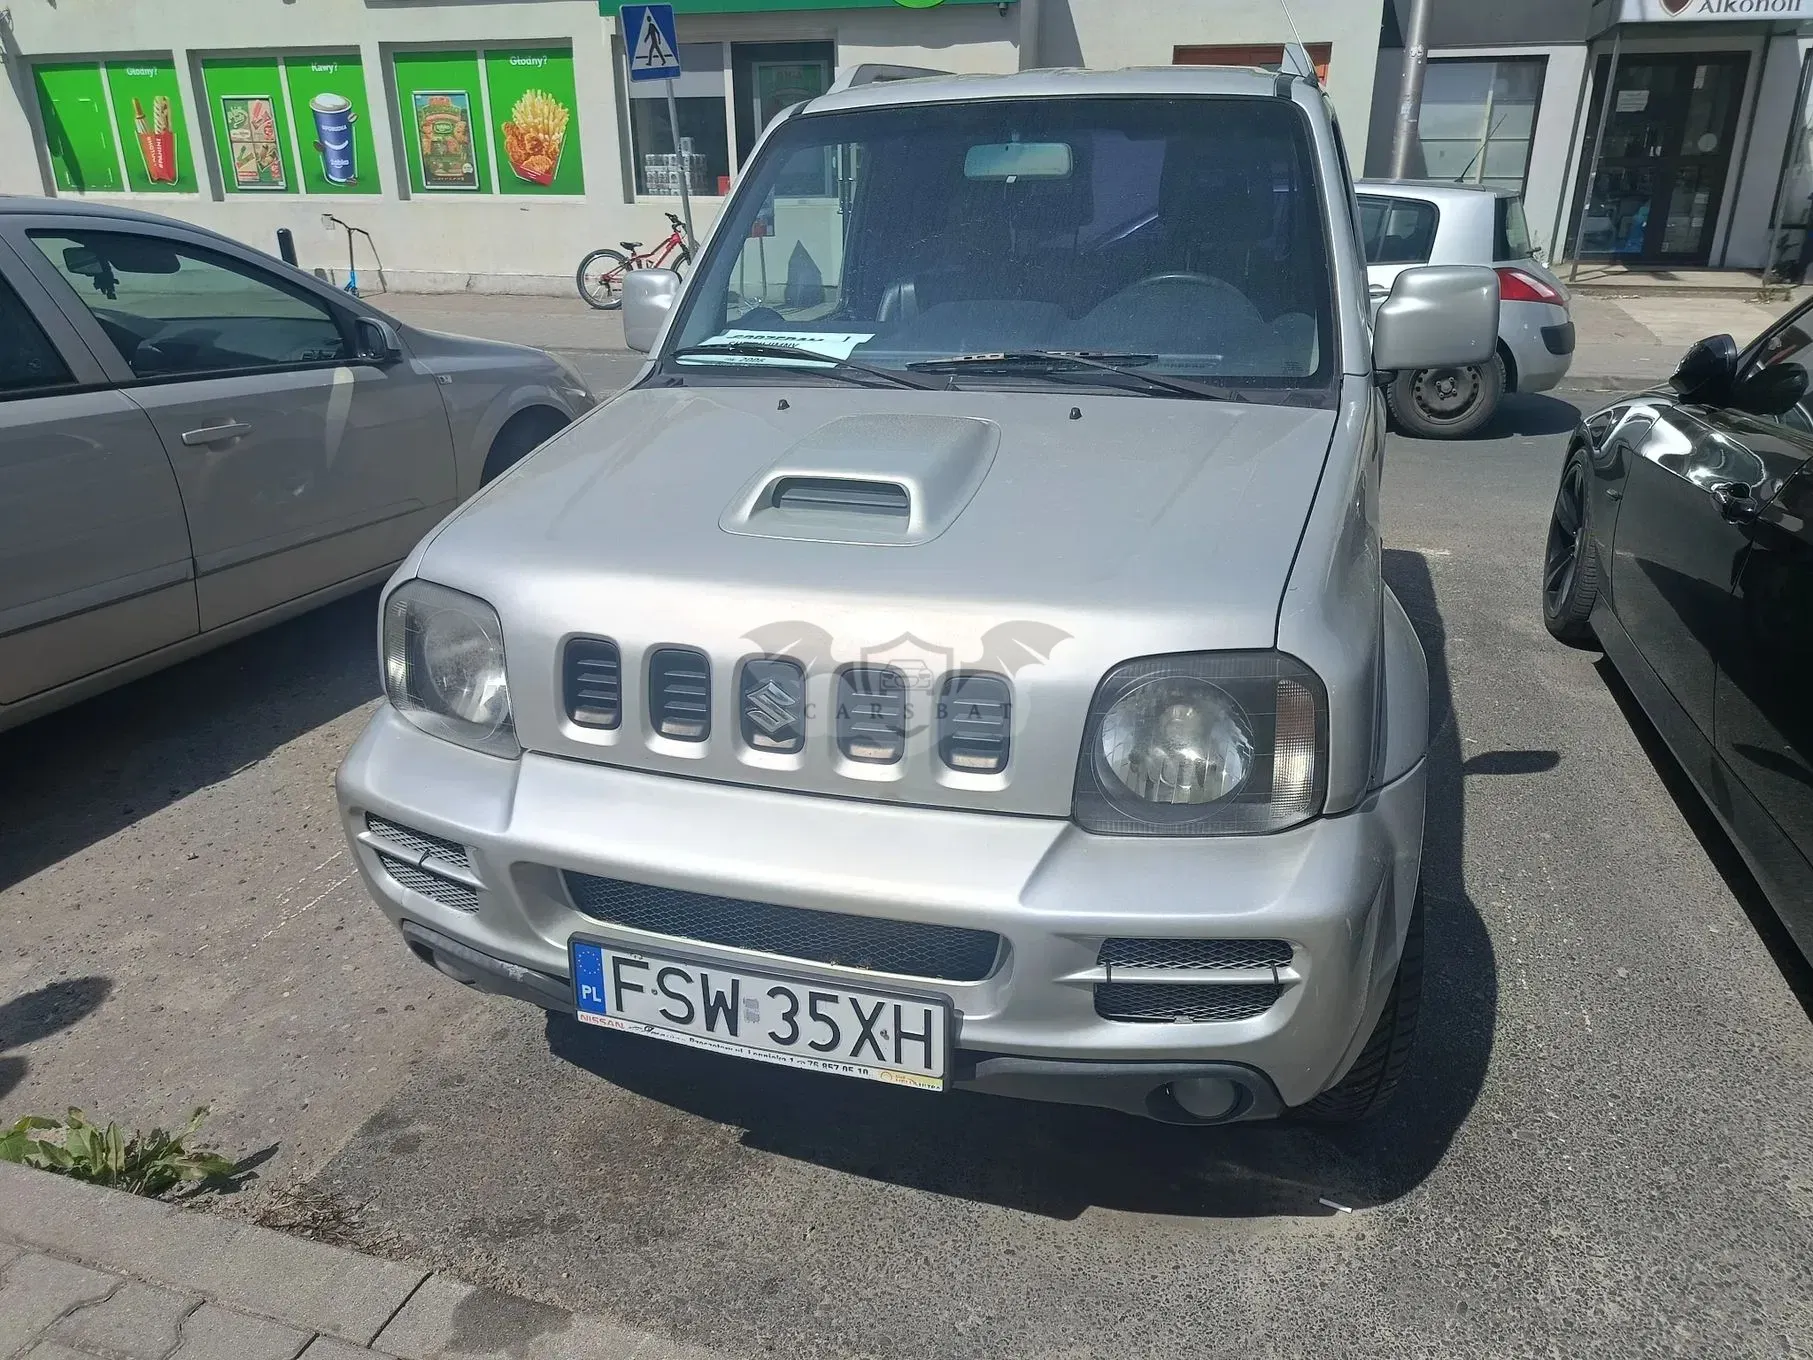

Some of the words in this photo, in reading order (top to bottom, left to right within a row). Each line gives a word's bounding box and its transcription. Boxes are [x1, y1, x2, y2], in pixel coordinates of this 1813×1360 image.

[311, 62, 338, 74] Kawy?
[581, 984, 602, 1003] PL
[580, 1013, 625, 1030] NISSAN
[612, 955, 741, 1038] FSW
[766, 985, 933, 1070] 35XH
